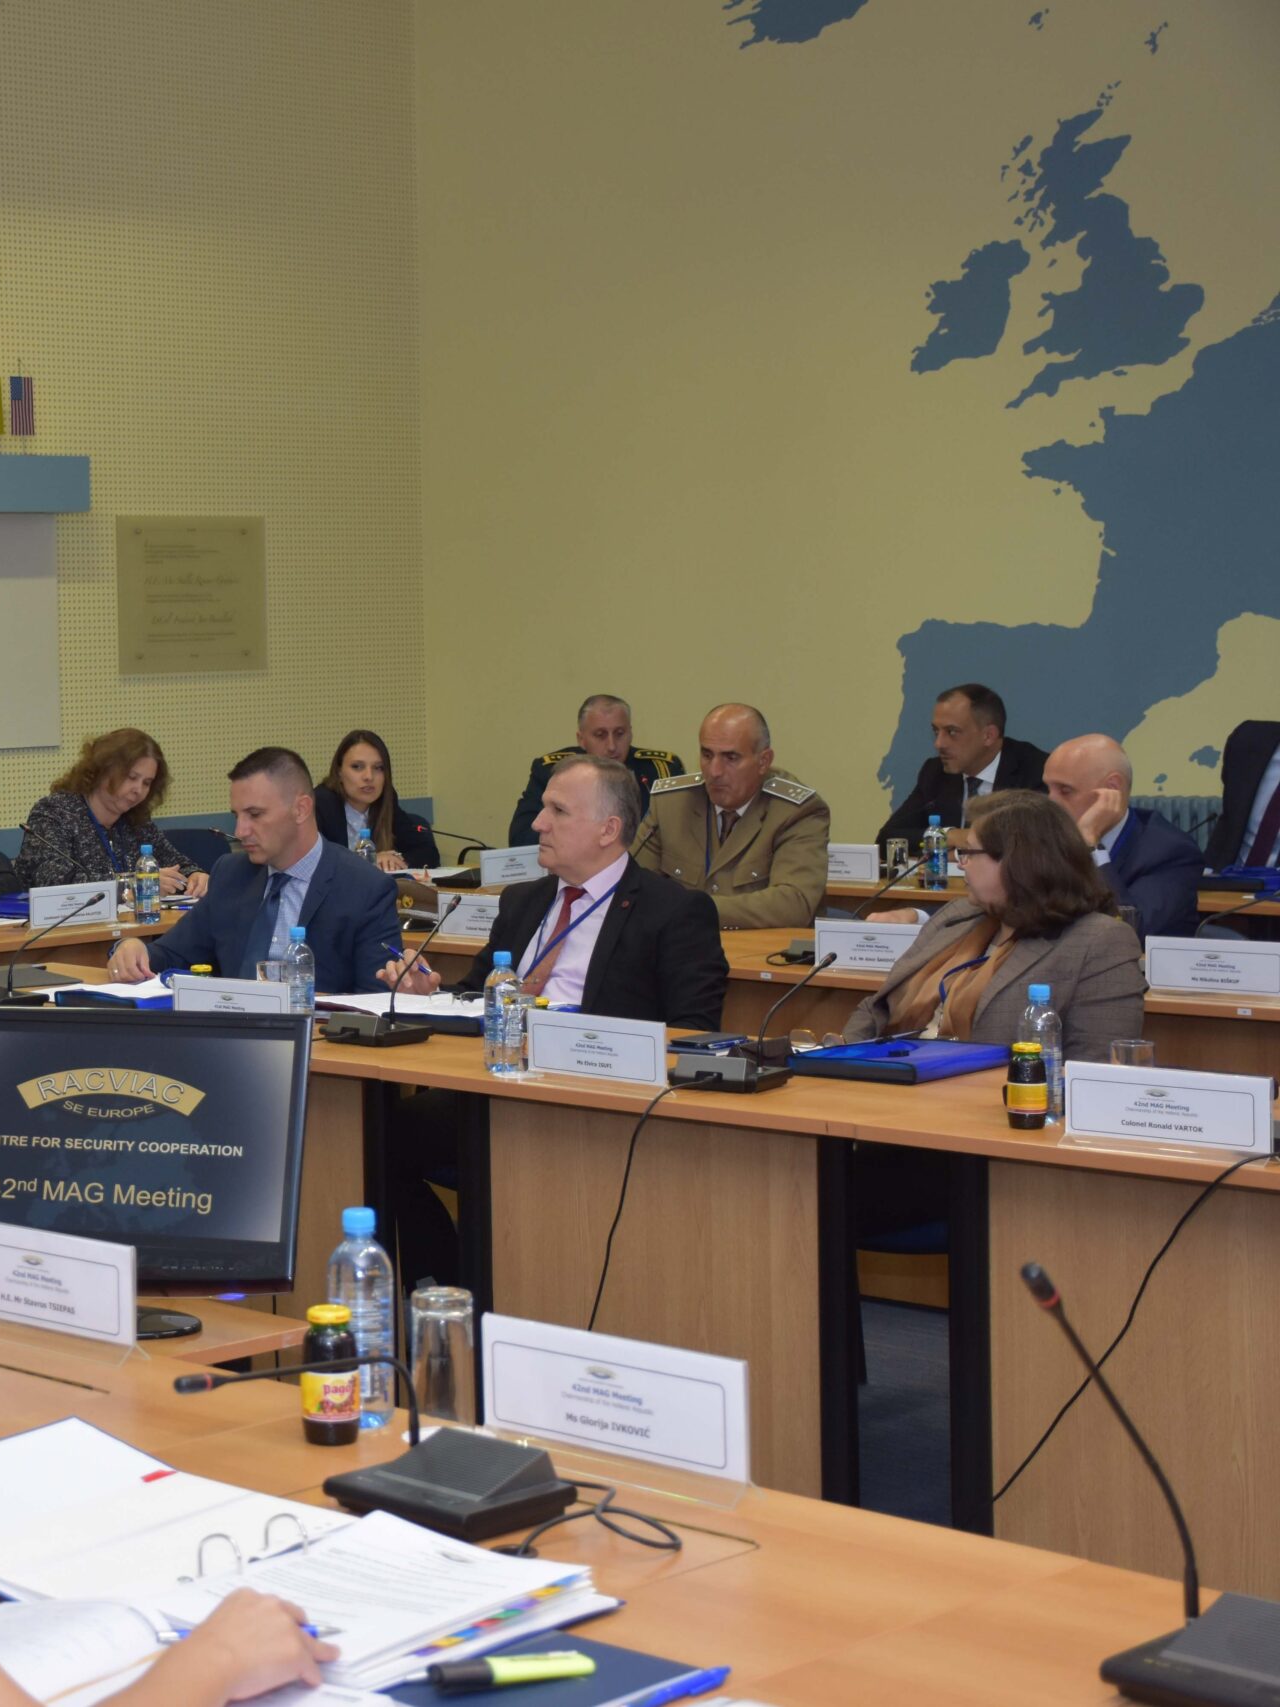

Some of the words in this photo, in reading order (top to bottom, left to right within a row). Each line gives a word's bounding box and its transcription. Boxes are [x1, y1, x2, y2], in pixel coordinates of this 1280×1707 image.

[37, 1070, 185, 1104] RACVIAC
[63, 1100, 84, 1114] SE
[87, 1103, 156, 1118] EUROPE
[1134, 1100, 1149, 1108] 42nd
[1165, 1103, 1190, 1112] Meeting
[1121, 1119, 1147, 1128] Colonel
[1148, 1122, 1172, 1130] Ronald
[1174, 1125, 1204, 1133] VARTOK
[31, 1136, 62, 1149] FOR
[64, 1137, 135, 1152] SECURITY
[138, 1141, 244, 1157] COOPERATION
[41, 1180, 105, 1204] MAG
[112, 1183, 213, 1215] Meeting
[12, 1269, 27, 1278] 42nd
[27, 1272, 40, 1281] MAG
[40, 1275, 62, 1287] Meeting
[1, 1292, 14, 1302] H.E.
[14, 1295, 23, 1303] Mr
[23, 1297, 48, 1309] Stavros
[49, 1302, 76, 1315] TSIEPAS
[323, 1384, 353, 1397] pago
[572, 1384, 592, 1394] 42nd
[592, 1387, 610, 1398] MAG
[611, 1391, 643, 1406] Meeting
[565, 1412, 579, 1423] Ms
[579, 1415, 609, 1430] Glorija
[610, 1422, 652, 1439] IVKOVIĆ
